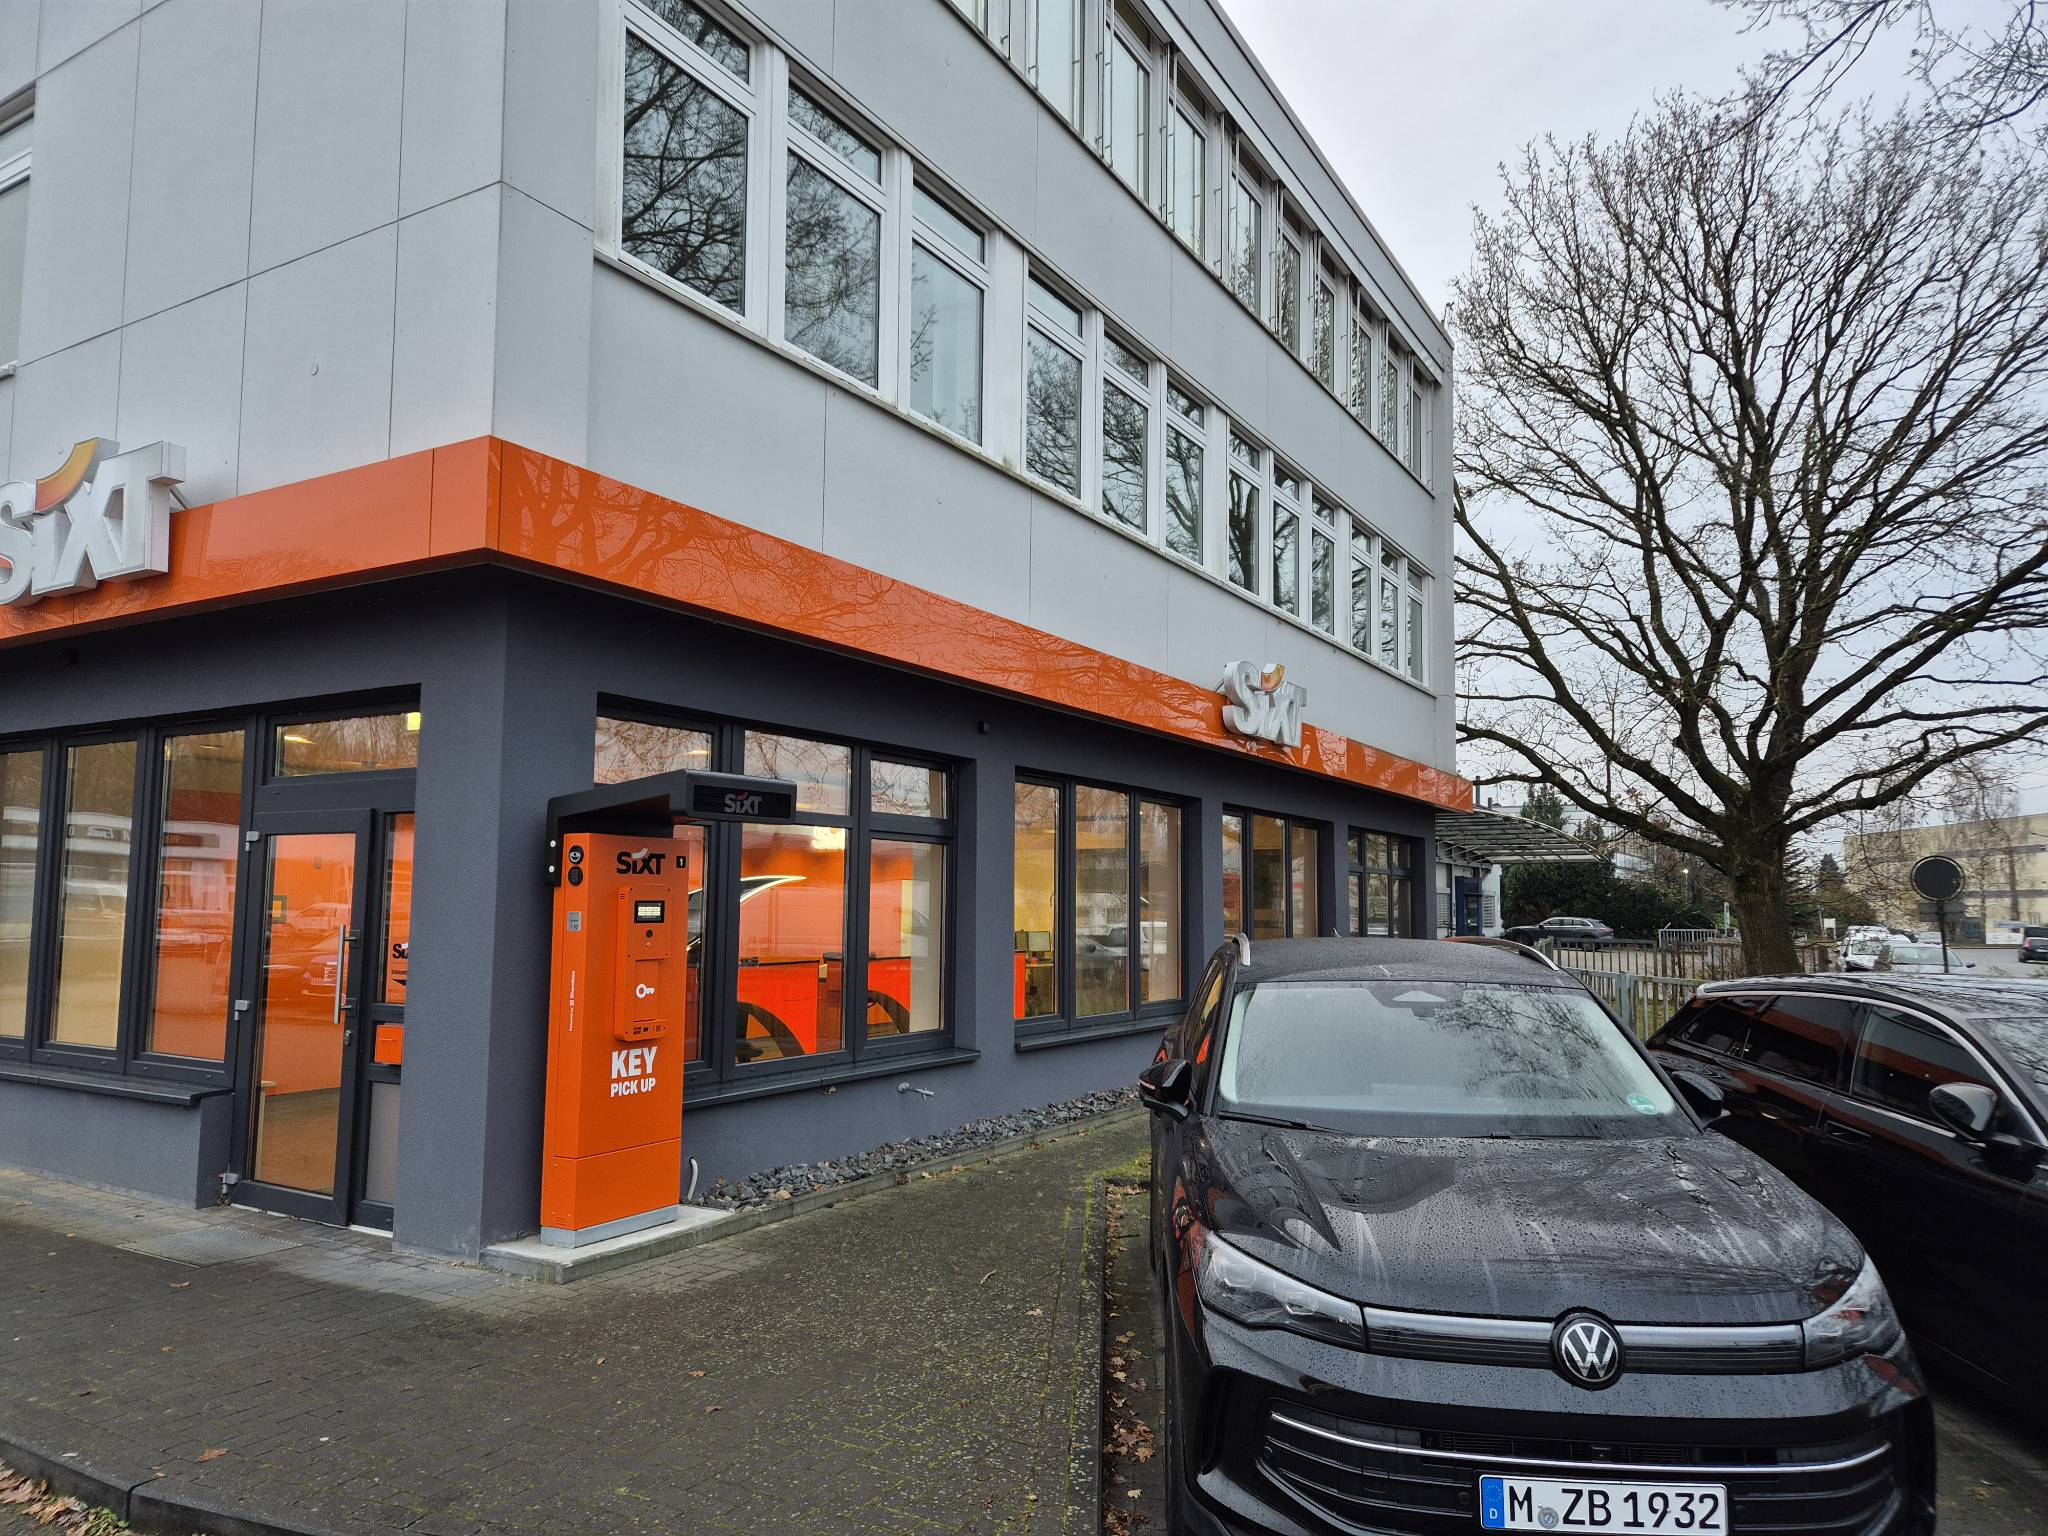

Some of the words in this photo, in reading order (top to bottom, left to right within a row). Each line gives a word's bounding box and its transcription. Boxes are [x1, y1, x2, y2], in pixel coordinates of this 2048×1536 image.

[611, 1046, 657, 1079] KEY
[610, 1080, 638, 1098] PICK
[640, 1077, 656, 1093] UP
[1489, 1508, 1498, 1519] D
[1508, 1485, 1533, 1523] M
[1561, 1488, 1612, 1526] ZB
[1622, 1491, 1721, 1530] 1932
